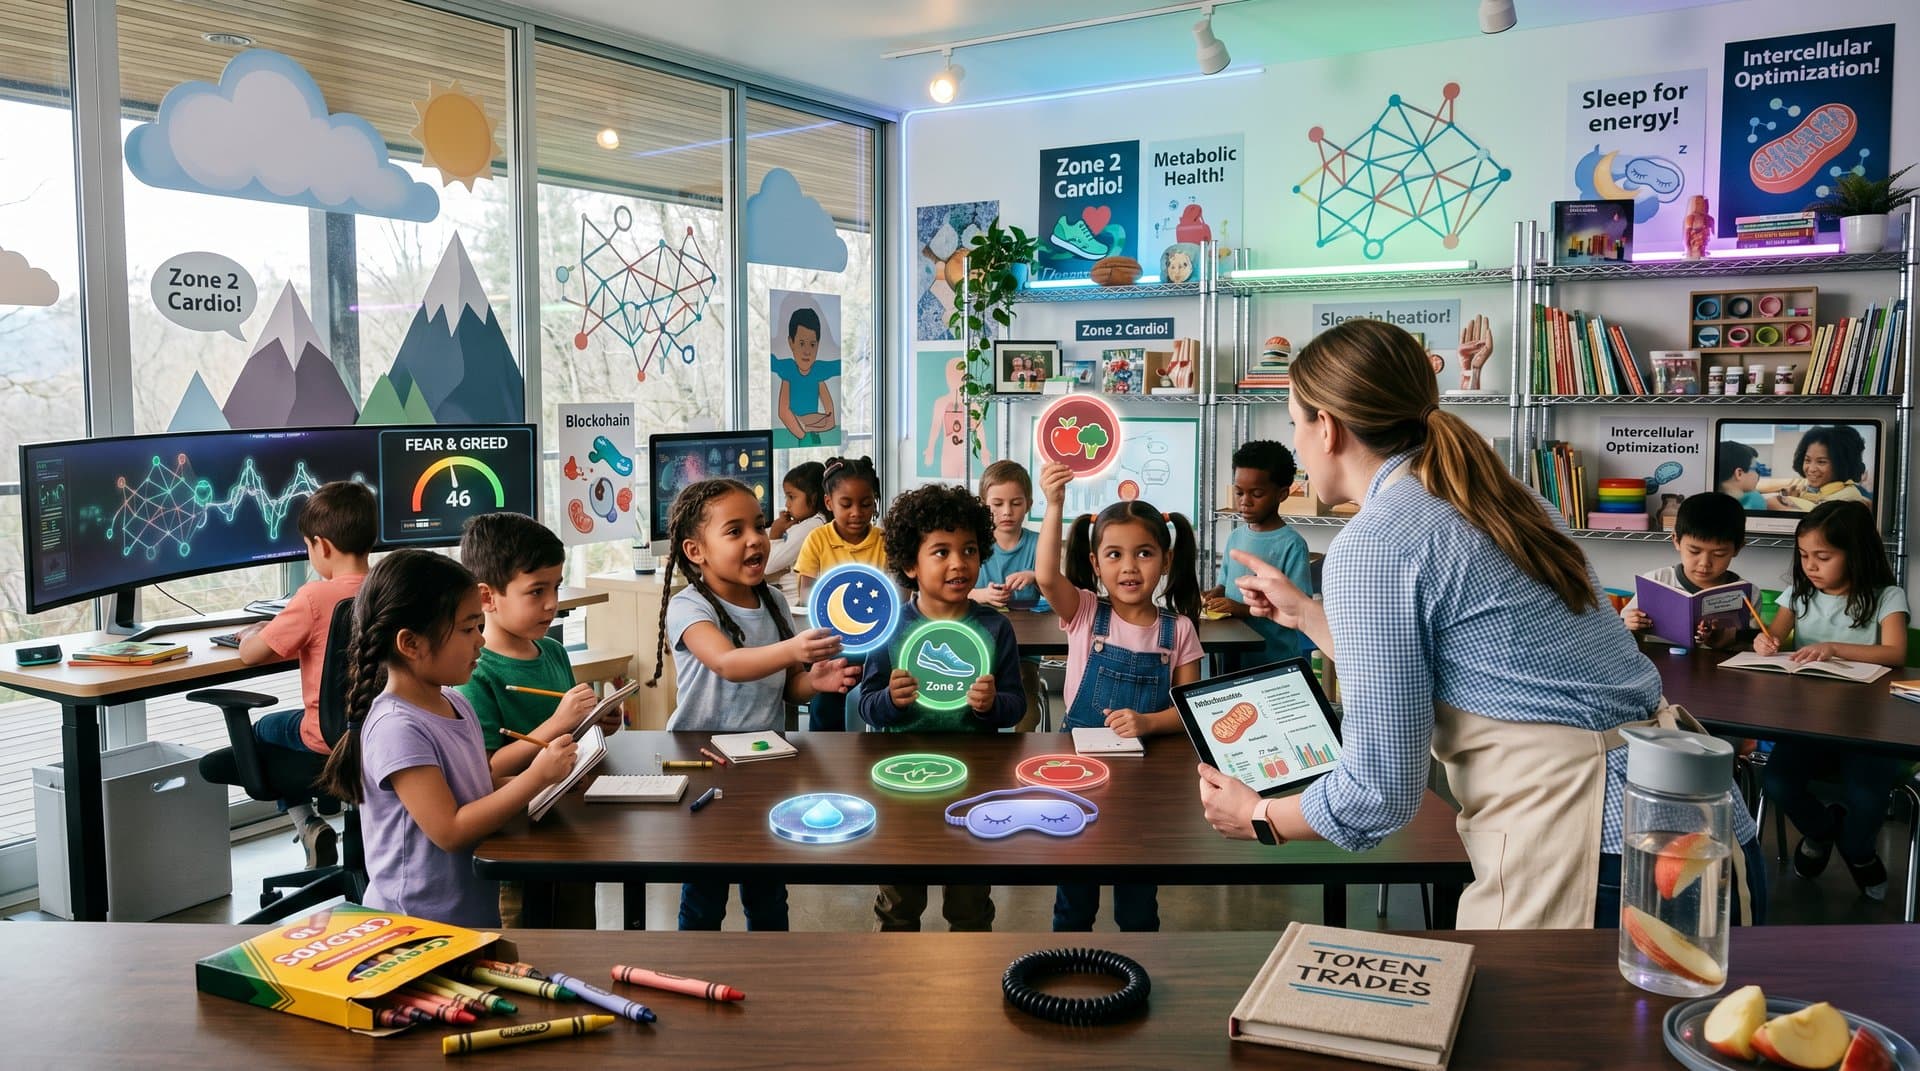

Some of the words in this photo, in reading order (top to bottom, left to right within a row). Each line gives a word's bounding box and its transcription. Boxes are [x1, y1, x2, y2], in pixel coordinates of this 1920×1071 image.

[1743, 39, 1873, 67] Intercellular
[1734, 57, 1880, 90] Optimization!
[1582, 89, 1647, 109] Sleep
[1653, 82, 1688, 102] for
[1589, 107, 1679, 132] energy!
[1056, 157, 1104, 177] Zone
[1109, 153, 1121, 172] 2
[1154, 146, 1237, 168] Metabolic
[1054, 175, 1123, 199] Cardio!
[1164, 167, 1224, 187] Health!
[169, 267, 222, 288] Zone
[227, 273, 239, 290] 2
[168, 291, 241, 312] Cardio!
[1082, 324, 1113, 337] Zone
[1115, 324, 1123, 336] 2
[1125, 322, 1168, 335] Cardio!
[1611, 426, 1694, 438] Intercellular
[405, 438, 443, 451] FEAR
[446, 437, 457, 450] &
[460, 436, 508, 450] GREED
[1606, 441, 1699, 454] Optimization!
[445, 489, 471, 508] 46
[925, 681, 954, 691] Zone
[956, 681, 964, 691] 2
[1313, 949, 1427, 978] TOKEN
[1296, 964, 1431, 997] TRADES
